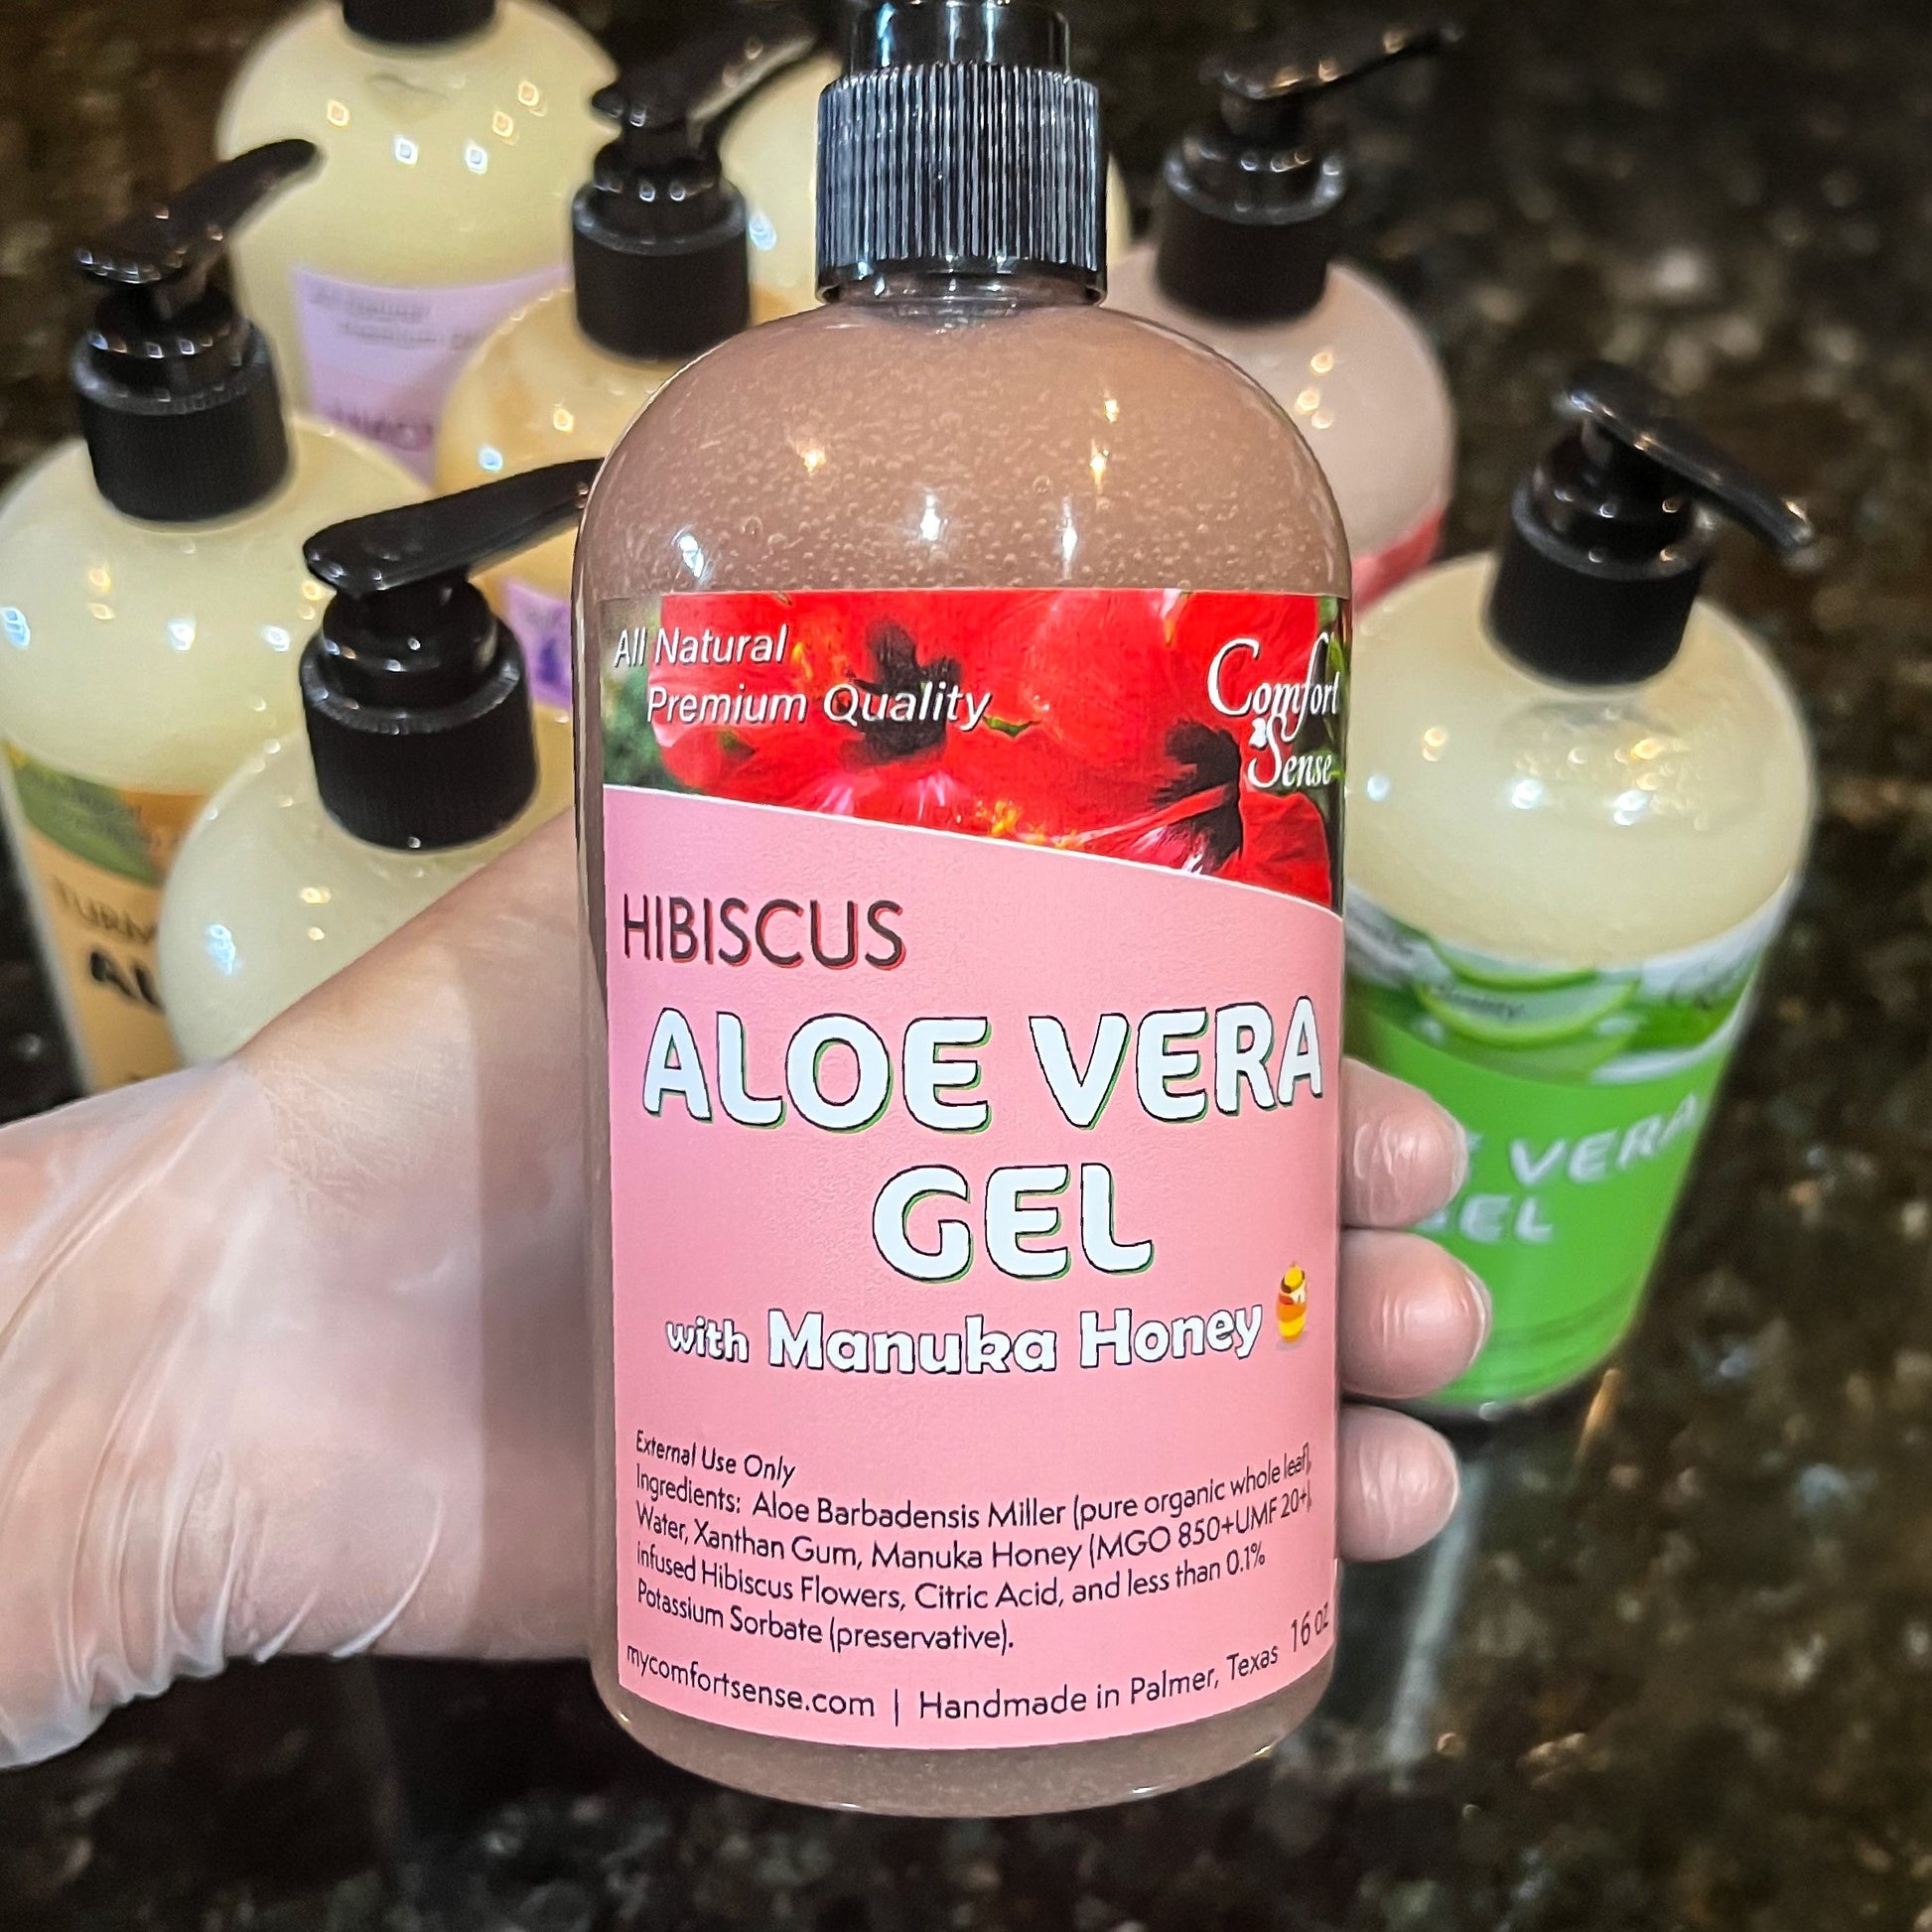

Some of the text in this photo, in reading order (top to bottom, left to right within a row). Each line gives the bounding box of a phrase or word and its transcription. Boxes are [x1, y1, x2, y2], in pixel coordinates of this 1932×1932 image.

[614, 623, 788, 667] All Natural
[646, 681, 992, 732] Premium Quality
[1207, 632, 1339, 743] Comfort
[1248, 713, 1332, 788] Sense
[623, 894, 906, 970] HIBISCUS
[642, 995, 1324, 1133] ALOE VERA
[1509, 1092, 1698, 1187] VERA
[872, 1162, 1155, 1284] GEL
[666, 1305, 1263, 1375] with Manuka Honey
[636, 1430, 795, 1488] External Use Only
[636, 1463, 742, 1514] Ingredients:
[753, 1491, 809, 1523] Aloe
[818, 1497, 979, 1529] Barbadensis
[988, 1497, 1065, 1528] Miller
[1073, 1494, 1138, 1531] (pure
[1144, 1478, 1225, 1519] organic
[1230, 1458, 1281, 1496] whole
[636, 1500, 689, 1545] Water,
[694, 1518, 784, 1560] Xanthan
[791, 1536, 863, 1570] Gum,
[872, 1541, 983, 1569] Manuka
[992, 1541, 1082, 1572] Honey
[1089, 1526, 1171, 1569] (MGO
[702, 1560, 793, 1599] Hibiscus
[801, 1575, 905, 1611] Flowers,
[915, 1583, 989, 1609] Citric
[995, 1577, 1063, 1607] Acid,
[1072, 1571, 1120, 1603] and
[1128, 1569, 1170, 1597] less
[1175, 1560, 1220, 1588] than
[1226, 1541, 1266, 1576] 0.1%
[637, 1578, 1014, 1656] Potassium Sorbate (preservative).
[627, 1644, 876, 1718] mycomfortsense.com
[919, 1684, 1087, 1720] Handmade
[1096, 1685, 1120, 1710] in
[1131, 1669, 1219, 1705] Palmer,
[1226, 1645, 1279, 1681] Texas
[1291, 1610, 1311, 1653] 16
[1314, 1601, 1329, 1636] oz
